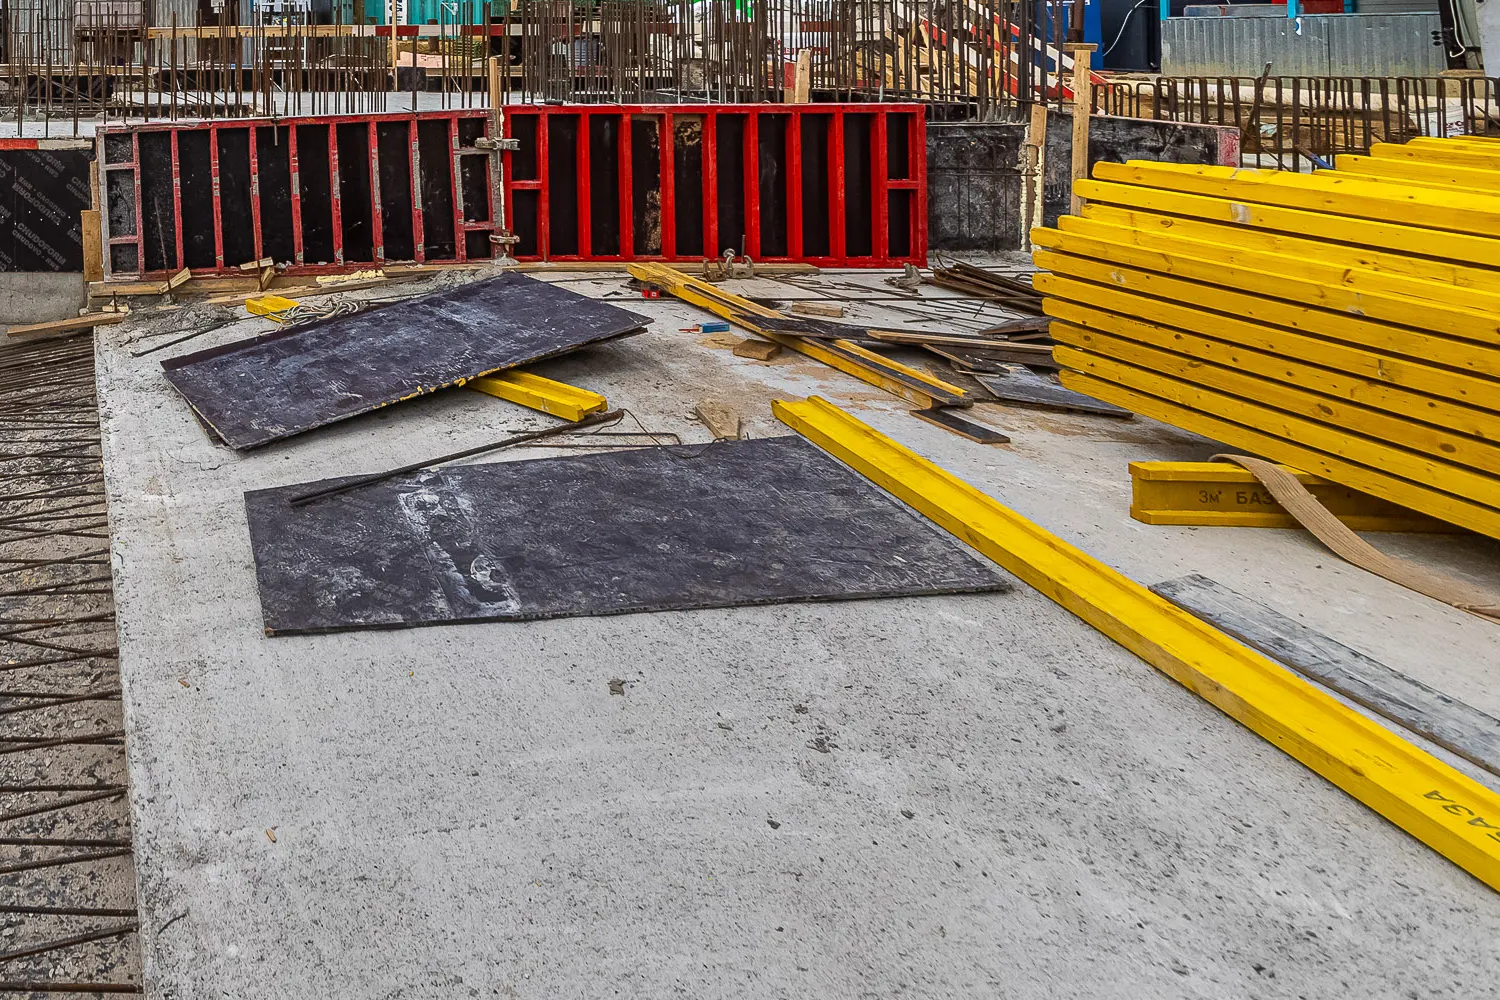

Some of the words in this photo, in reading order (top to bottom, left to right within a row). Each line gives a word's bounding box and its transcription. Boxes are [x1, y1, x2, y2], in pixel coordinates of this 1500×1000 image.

[12, 182, 61, 225] CHUDOFORM
[18, 222, 67, 264] CHUDOFORM
[1236, 491, 1275, 504] БАЗ
